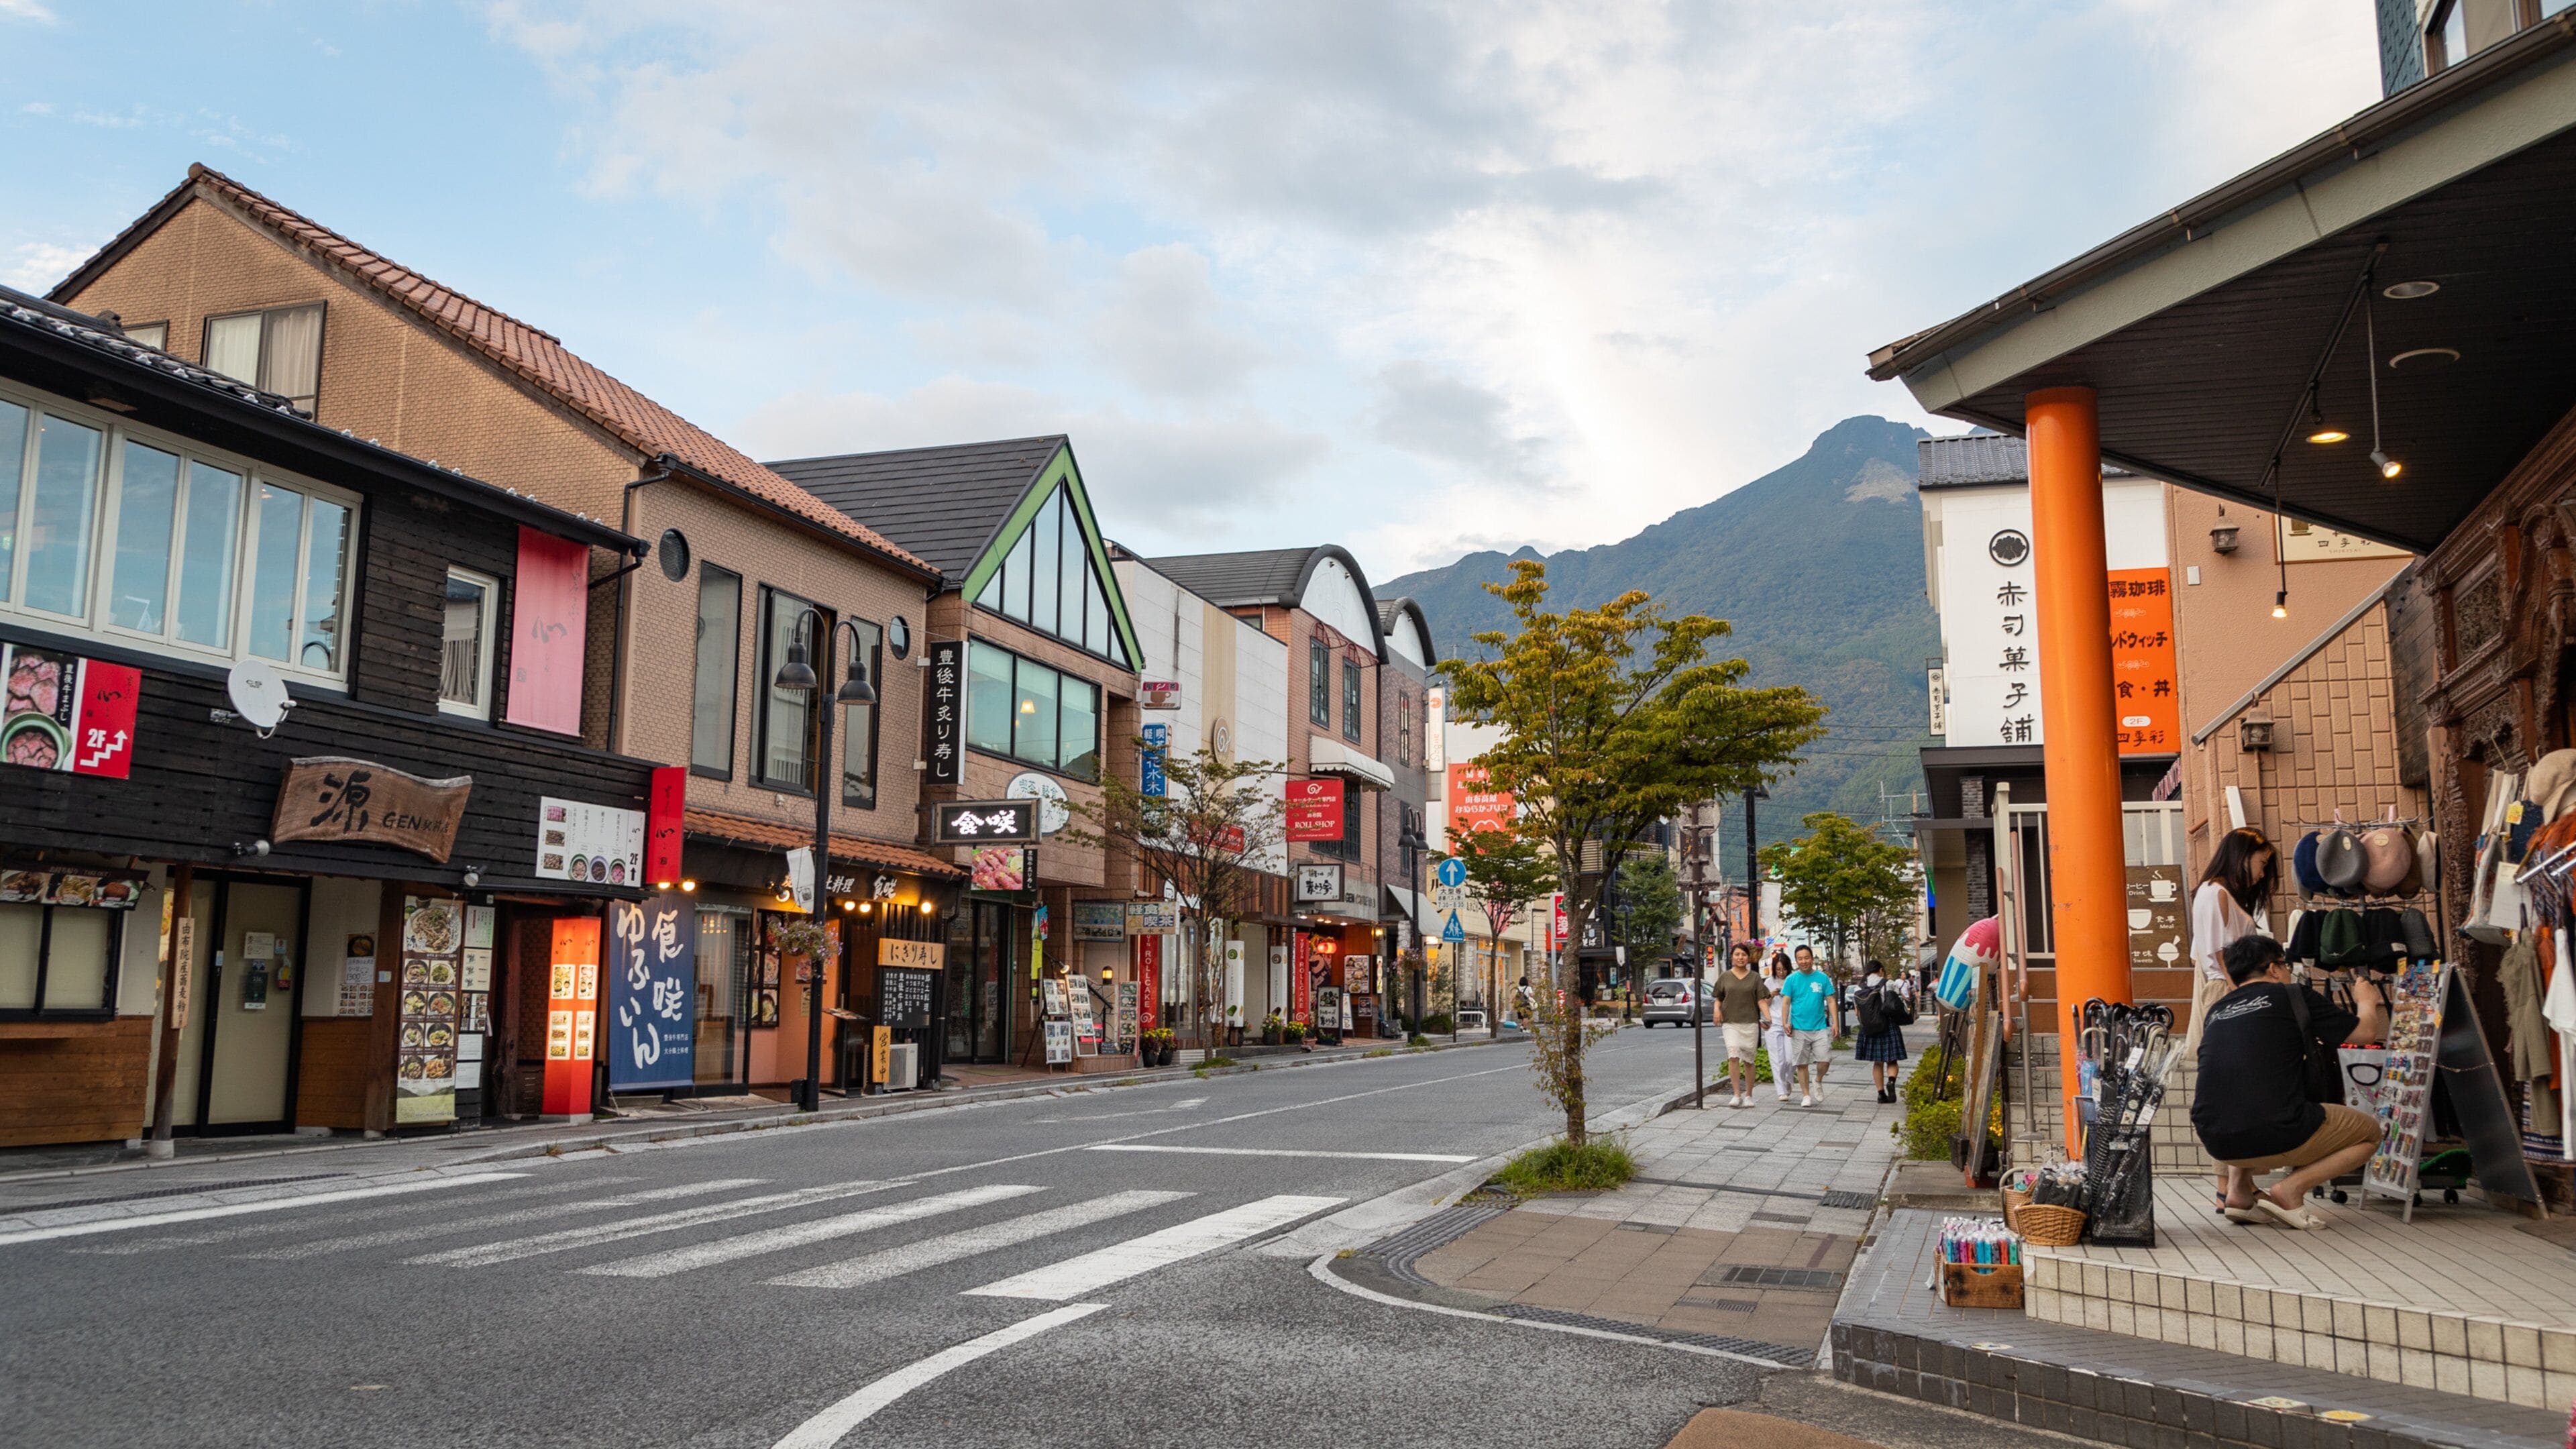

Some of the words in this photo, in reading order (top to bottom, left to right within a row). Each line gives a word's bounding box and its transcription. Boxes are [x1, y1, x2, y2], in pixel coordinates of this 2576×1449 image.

[1997, 581, 2034, 743] 赤司菓子舗
[934, 649, 955, 777] 豊後牛炙り寿し
[87, 729, 107, 748] 2F
[2117, 730, 2164, 747] 四季彩
[310, 769, 372, 834] 源
[382, 811, 422, 830] GEN
[1295, 820, 1312, 828] ROLL
[1315, 820, 1335, 828] SHOP
[630, 853, 639, 865] 2F
[1128, 904, 1159, 915] 軽食
[1144, 915, 1174, 926] 喫茶
[890, 943, 938, 965] にぎり寿し
[616, 903, 660, 1069] ゆふいん
[1144, 950, 1152, 1008] ROLLCAKE
[879, 1032, 889, 1080] 営業中
